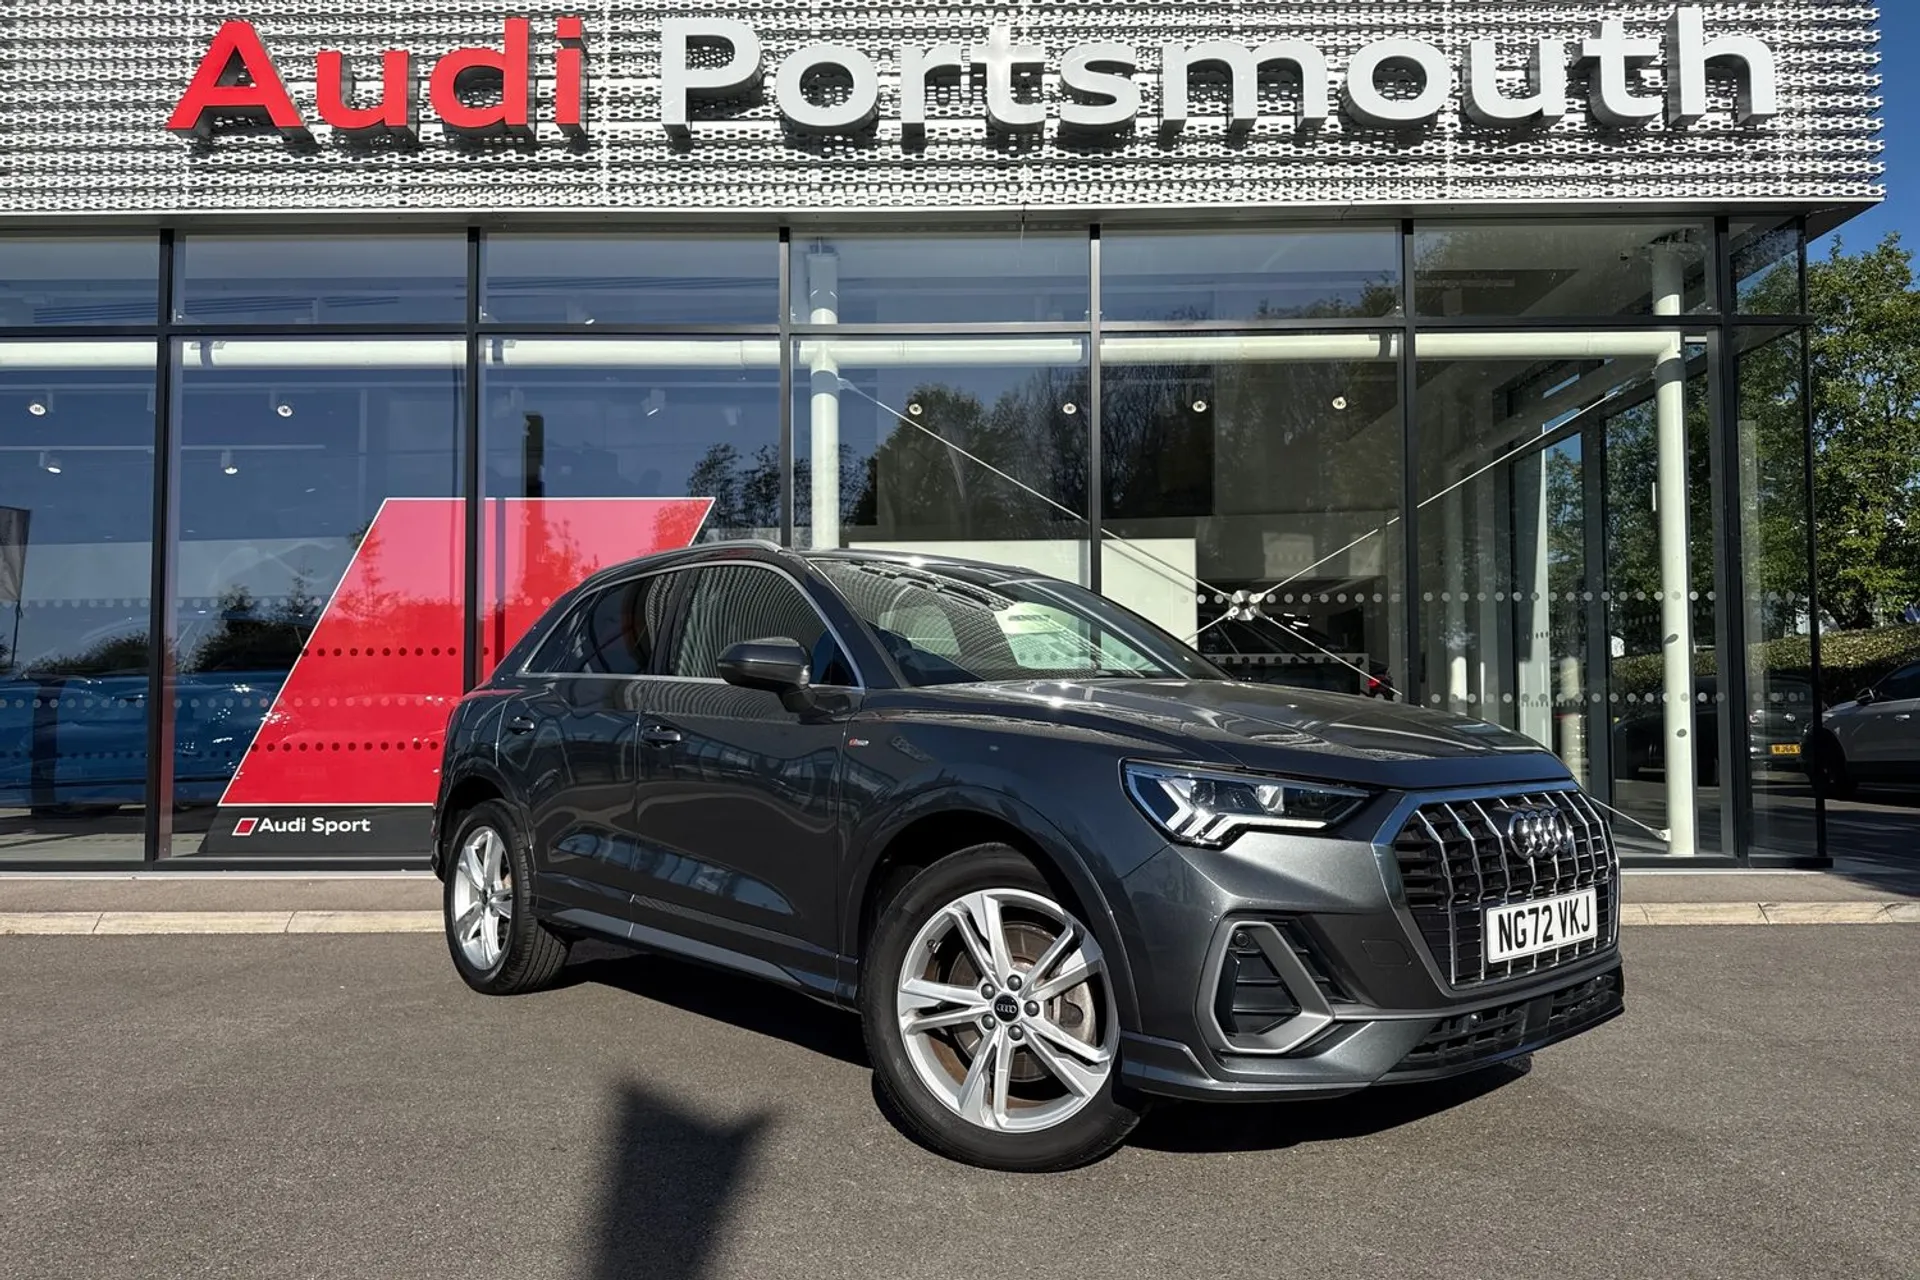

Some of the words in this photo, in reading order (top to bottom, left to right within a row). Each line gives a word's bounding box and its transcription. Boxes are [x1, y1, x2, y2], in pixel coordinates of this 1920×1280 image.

[166, 16, 584, 129] Audi
[659, 6, 1778, 134] Portsmouth
[258, 817, 306, 832] Audi
[311, 817, 371, 836] Sport
[1498, 905, 1554, 953] NG72
[1558, 895, 1590, 938] VKJ
